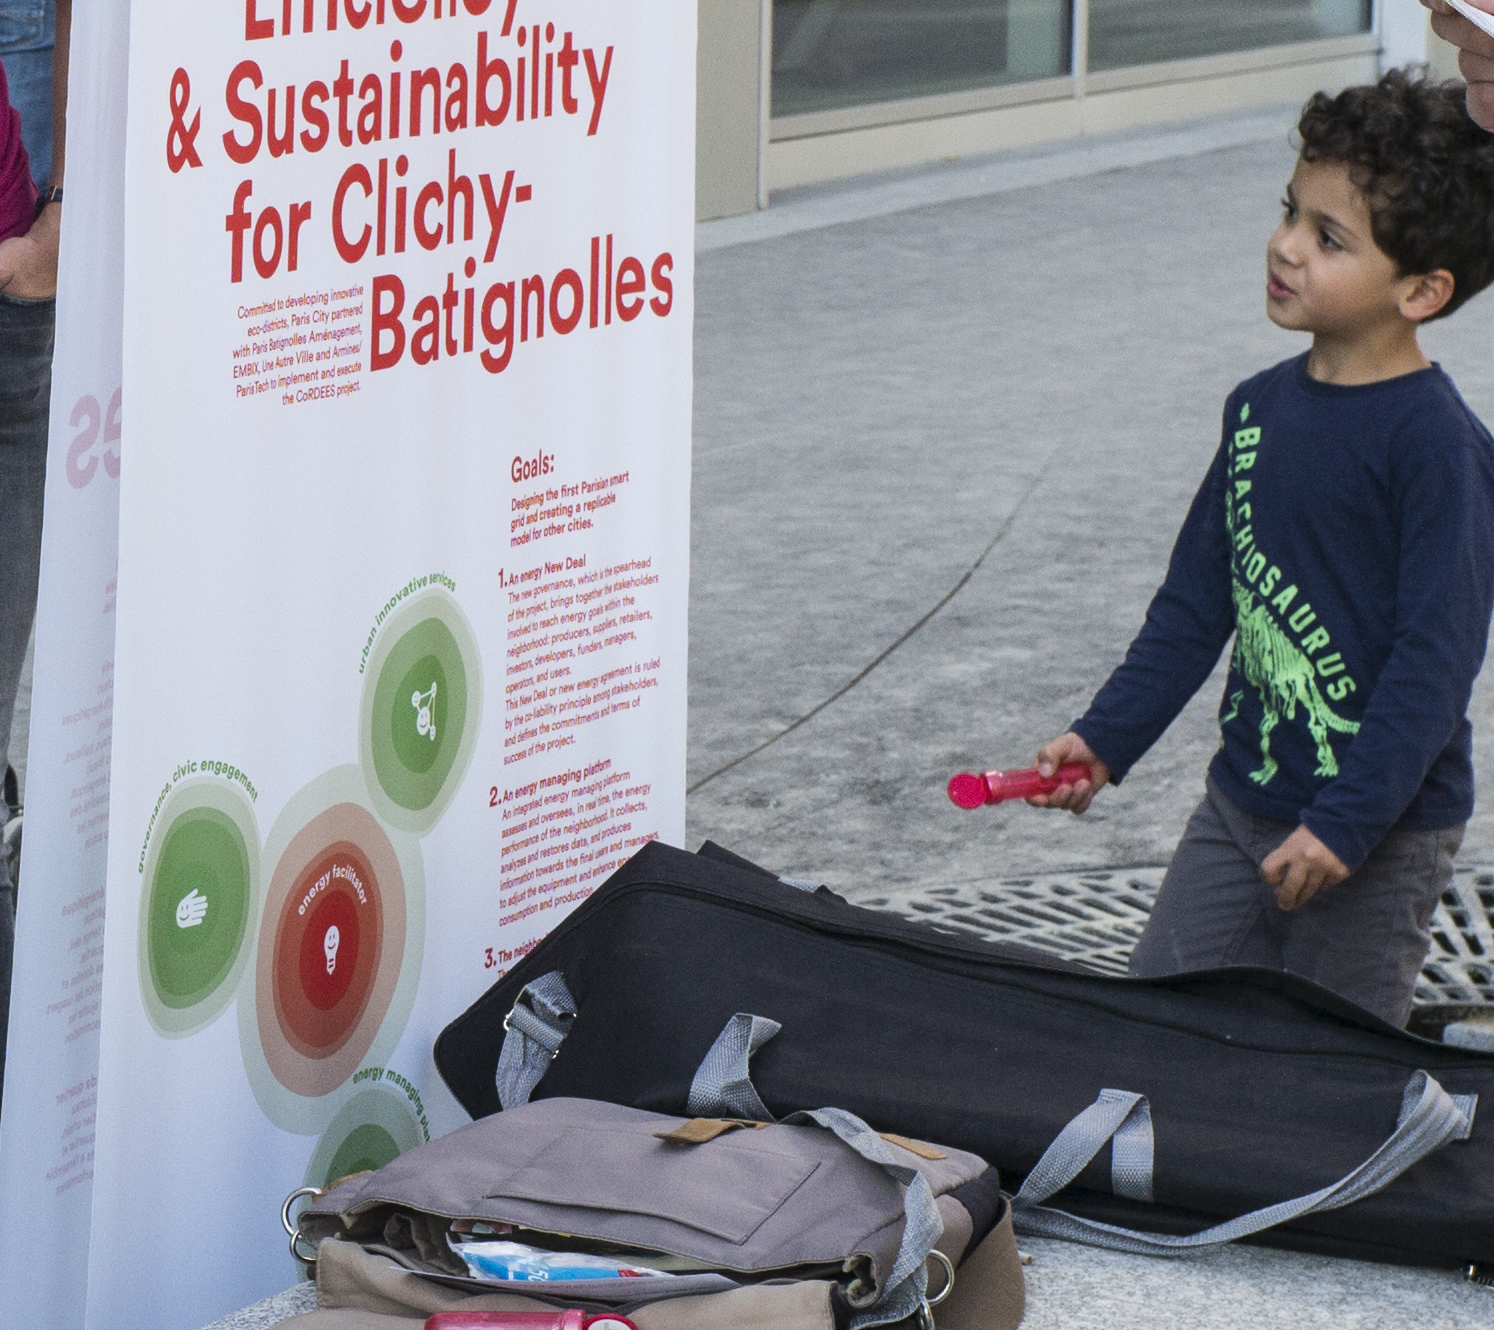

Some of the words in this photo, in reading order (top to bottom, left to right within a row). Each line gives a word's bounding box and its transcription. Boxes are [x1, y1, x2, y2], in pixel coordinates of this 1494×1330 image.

[167, 68, 202, 173] &
[223, 26, 613, 164] Sustainability
[226, 180, 311, 282] for
[332, 149, 531, 263] Clichy-
[238, 299, 276, 319] Committed
[277, 301, 284, 310] to
[285, 292, 329, 309] developing
[331, 285, 363, 301] innovative
[291, 313, 310, 326] Paris
[313, 309, 329, 324] City
[332, 302, 363, 323] partnered
[371, 235, 673, 373] Batignolles
[511, 449, 554, 483] Goals:
[511, 516, 524, 533] grid
[526, 510, 537, 524] and
[540, 502, 573, 521] creating
[575, 503, 580, 512] a
[584, 491, 616, 512] replicable
[512, 492, 544, 511] Designing
[546, 488, 558, 500] the
[561, 484, 578, 498] first
[582, 477, 608, 494] Parisian
[610, 471, 629, 487] smart
[511, 530, 531, 547] model
[532, 527, 542, 541] for
[544, 522, 565, 536] other
[568, 517, 593, 532] cities.
[498, 568, 507, 588] 1.
[509, 573, 519, 586] An
[520, 566, 543, 583] energy
[544, 561, 564, 575] New
[566, 554, 586, 569] Deal
[1235, 426, 1356, 700] BRACHIOSAURUS
[359, 627, 377, 674] urban
[375, 576, 427, 626] innovative
[429, 571, 456, 592] services
[173, 760, 197, 782] civic
[200, 760, 258, 803] engagement
[489, 786, 501, 807] 2.
[503, 790, 513, 803] An
[515, 783, 537, 799] energy
[540, 770, 582, 789] managing
[584, 758, 611, 780] platform
[298, 870, 330, 915] energy
[333, 864, 367, 905] facilitator
[353, 1067, 384, 1084] energy
[386, 1070, 423, 1115] managing
